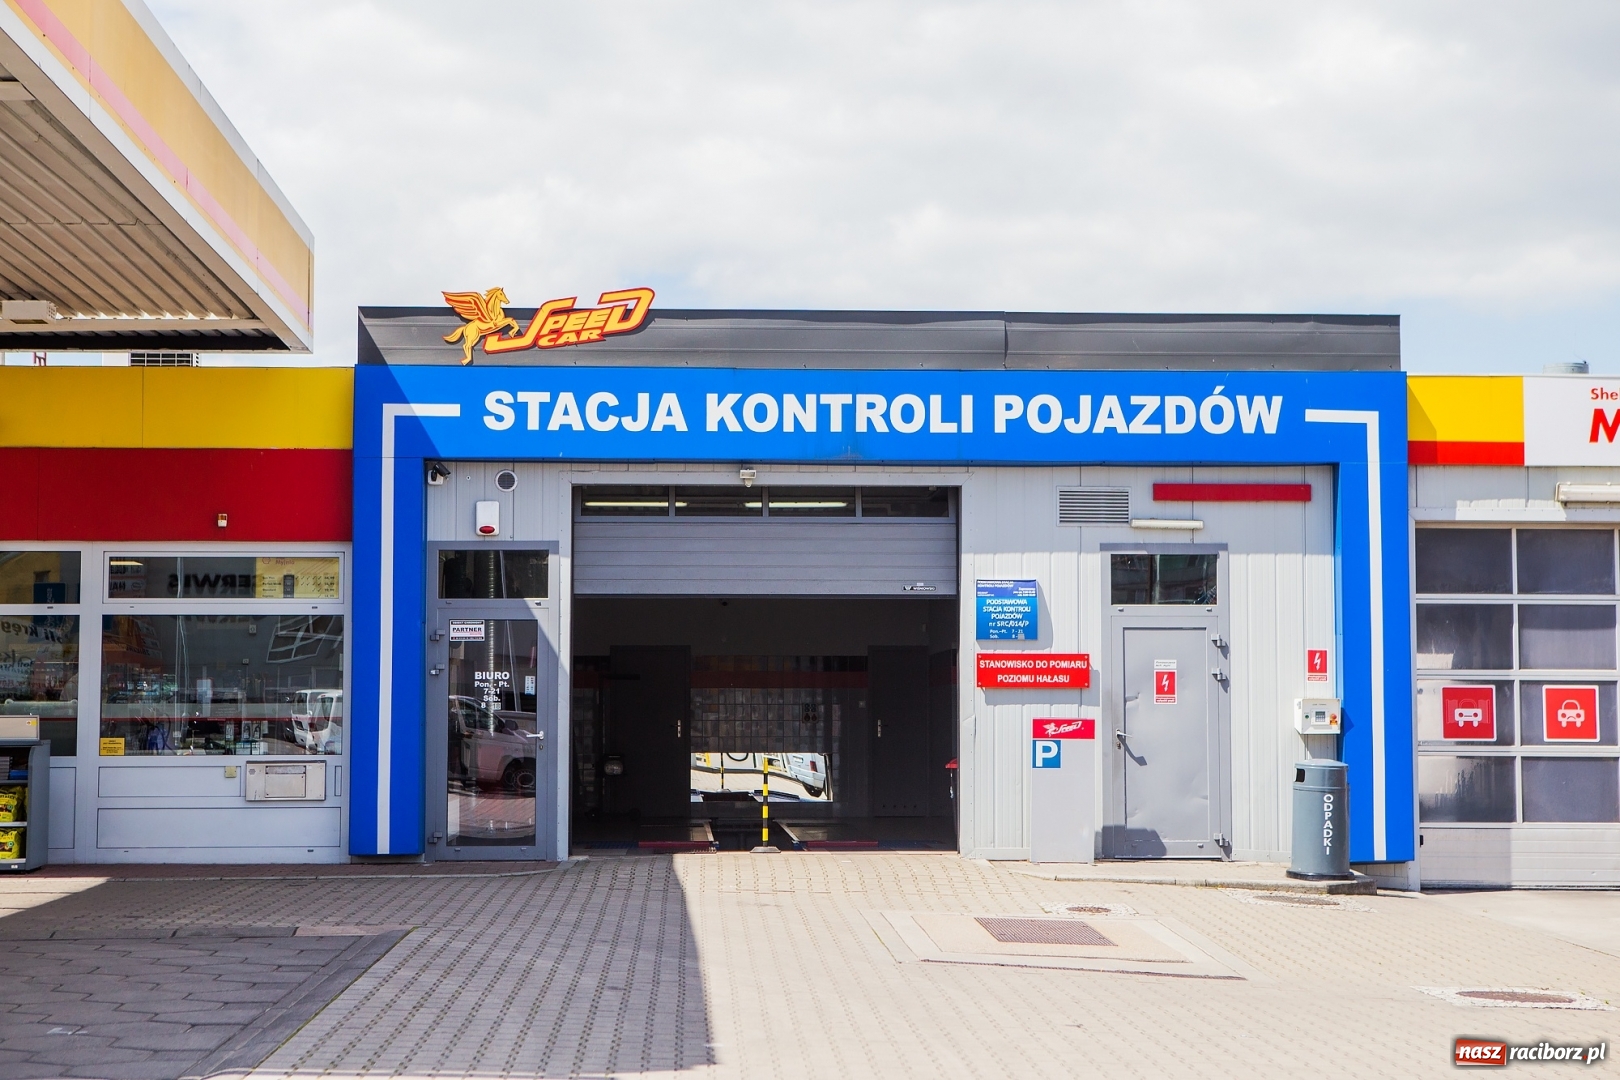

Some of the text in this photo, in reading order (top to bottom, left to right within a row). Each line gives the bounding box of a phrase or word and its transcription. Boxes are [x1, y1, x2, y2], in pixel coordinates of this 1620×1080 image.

[537, 329, 603, 348] CAR
[1590, 387, 1620, 400] She
[484, 386, 1283, 434] STACJA KONTROLI POJAZDÓW
[979, 659, 1087, 669] STANOWISKO DO POMIARU
[474, 671, 510, 680] BIURO
[997, 674, 1070, 683] POZIOMU HAŁASU
[498, 680, 510, 688] Pt.
[483, 694, 501, 702] Sob.
[1036, 741, 1059, 768] P
[1323, 793, 1334, 856] ODPADKI
